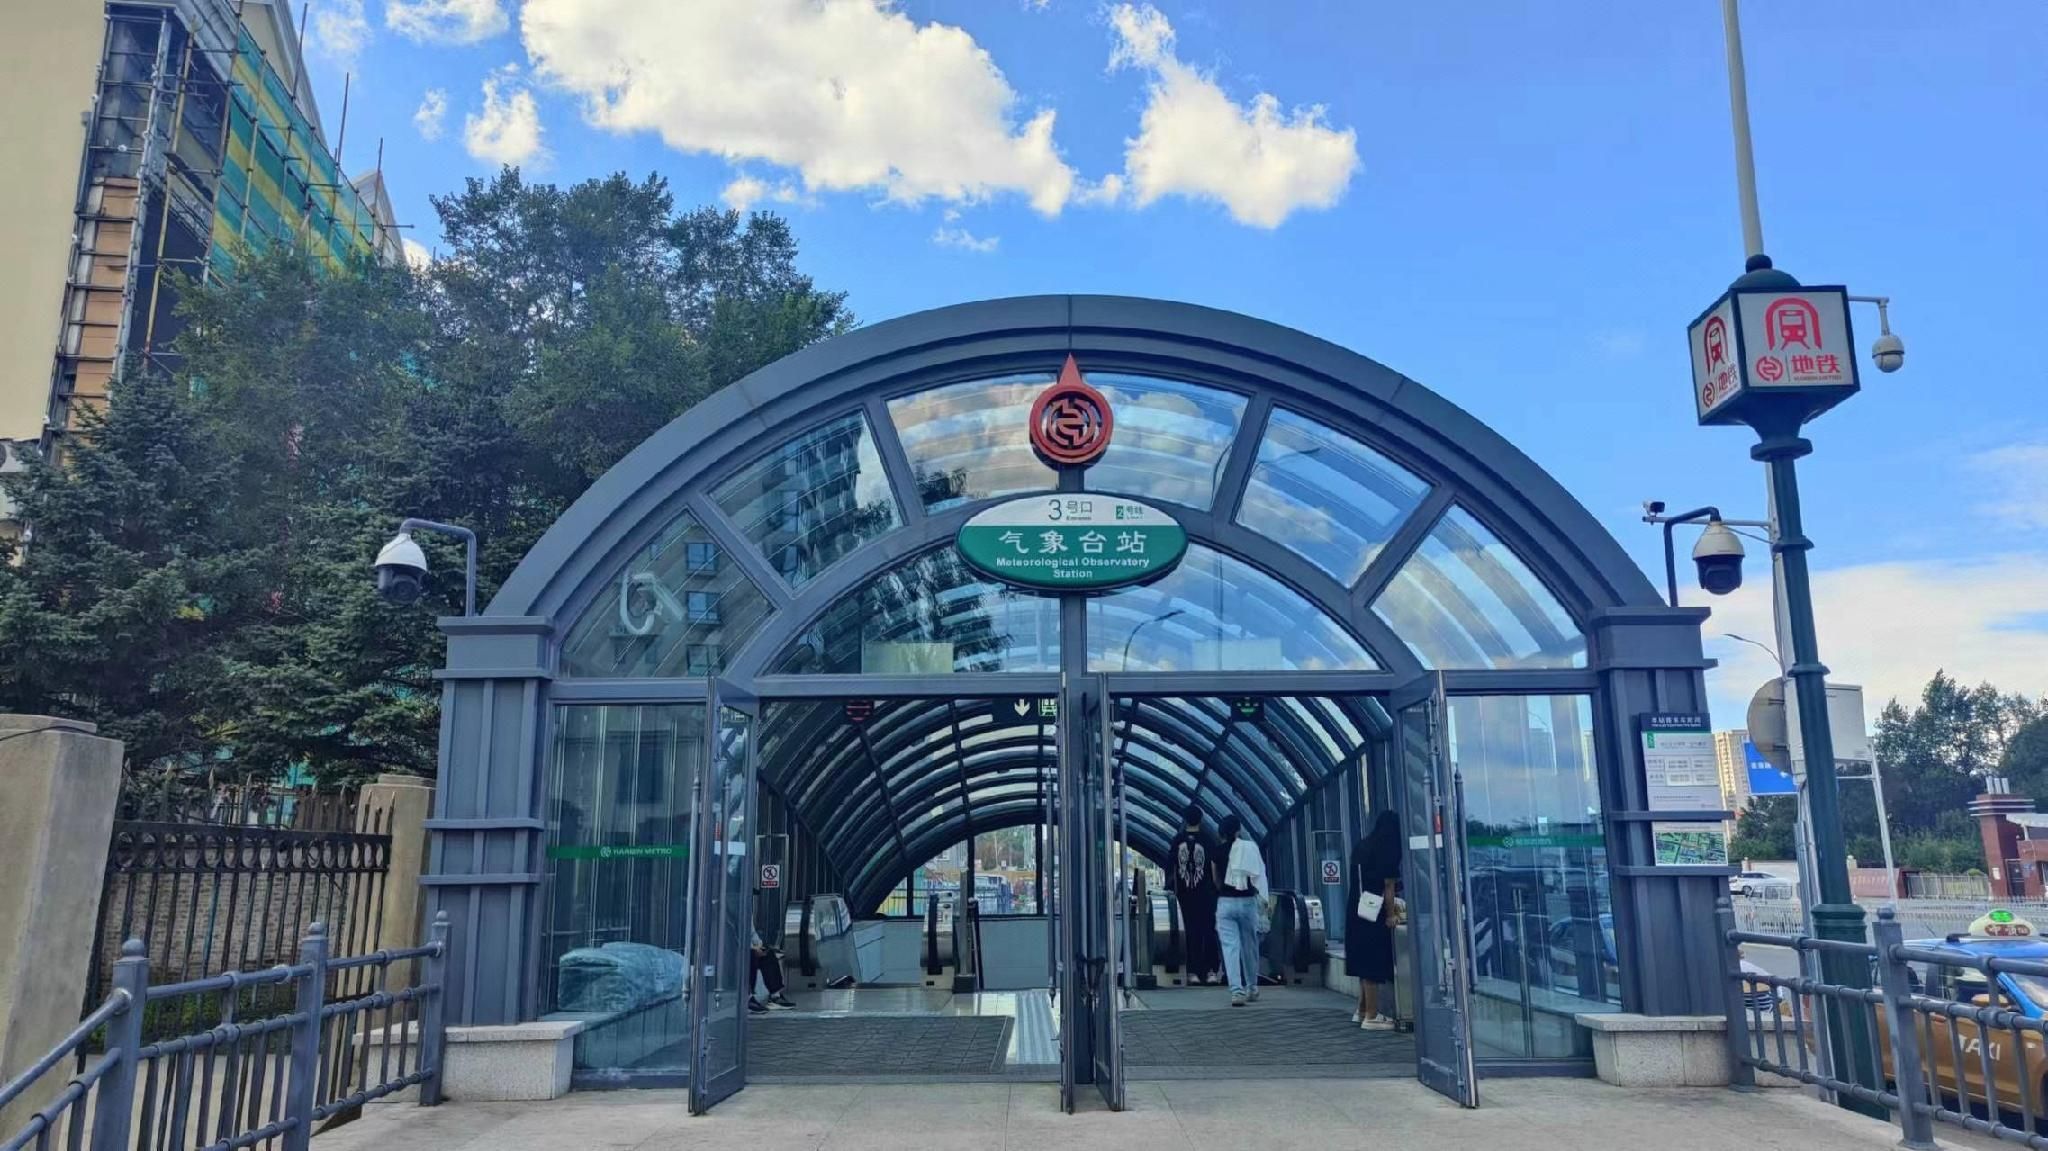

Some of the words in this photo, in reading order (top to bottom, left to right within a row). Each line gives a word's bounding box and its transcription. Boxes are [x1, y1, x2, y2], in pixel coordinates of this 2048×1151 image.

[1791, 354, 1840, 374] 地铁
[1719, 363, 1738, 390] 地铁
[1048, 499, 1093, 521] 3号口
[998, 530, 1147, 554] 气象台站
[996, 557, 1079, 568] Meteorological
[1081, 557, 1150, 568] Observatory
[1053, 569, 1093, 579] Station
